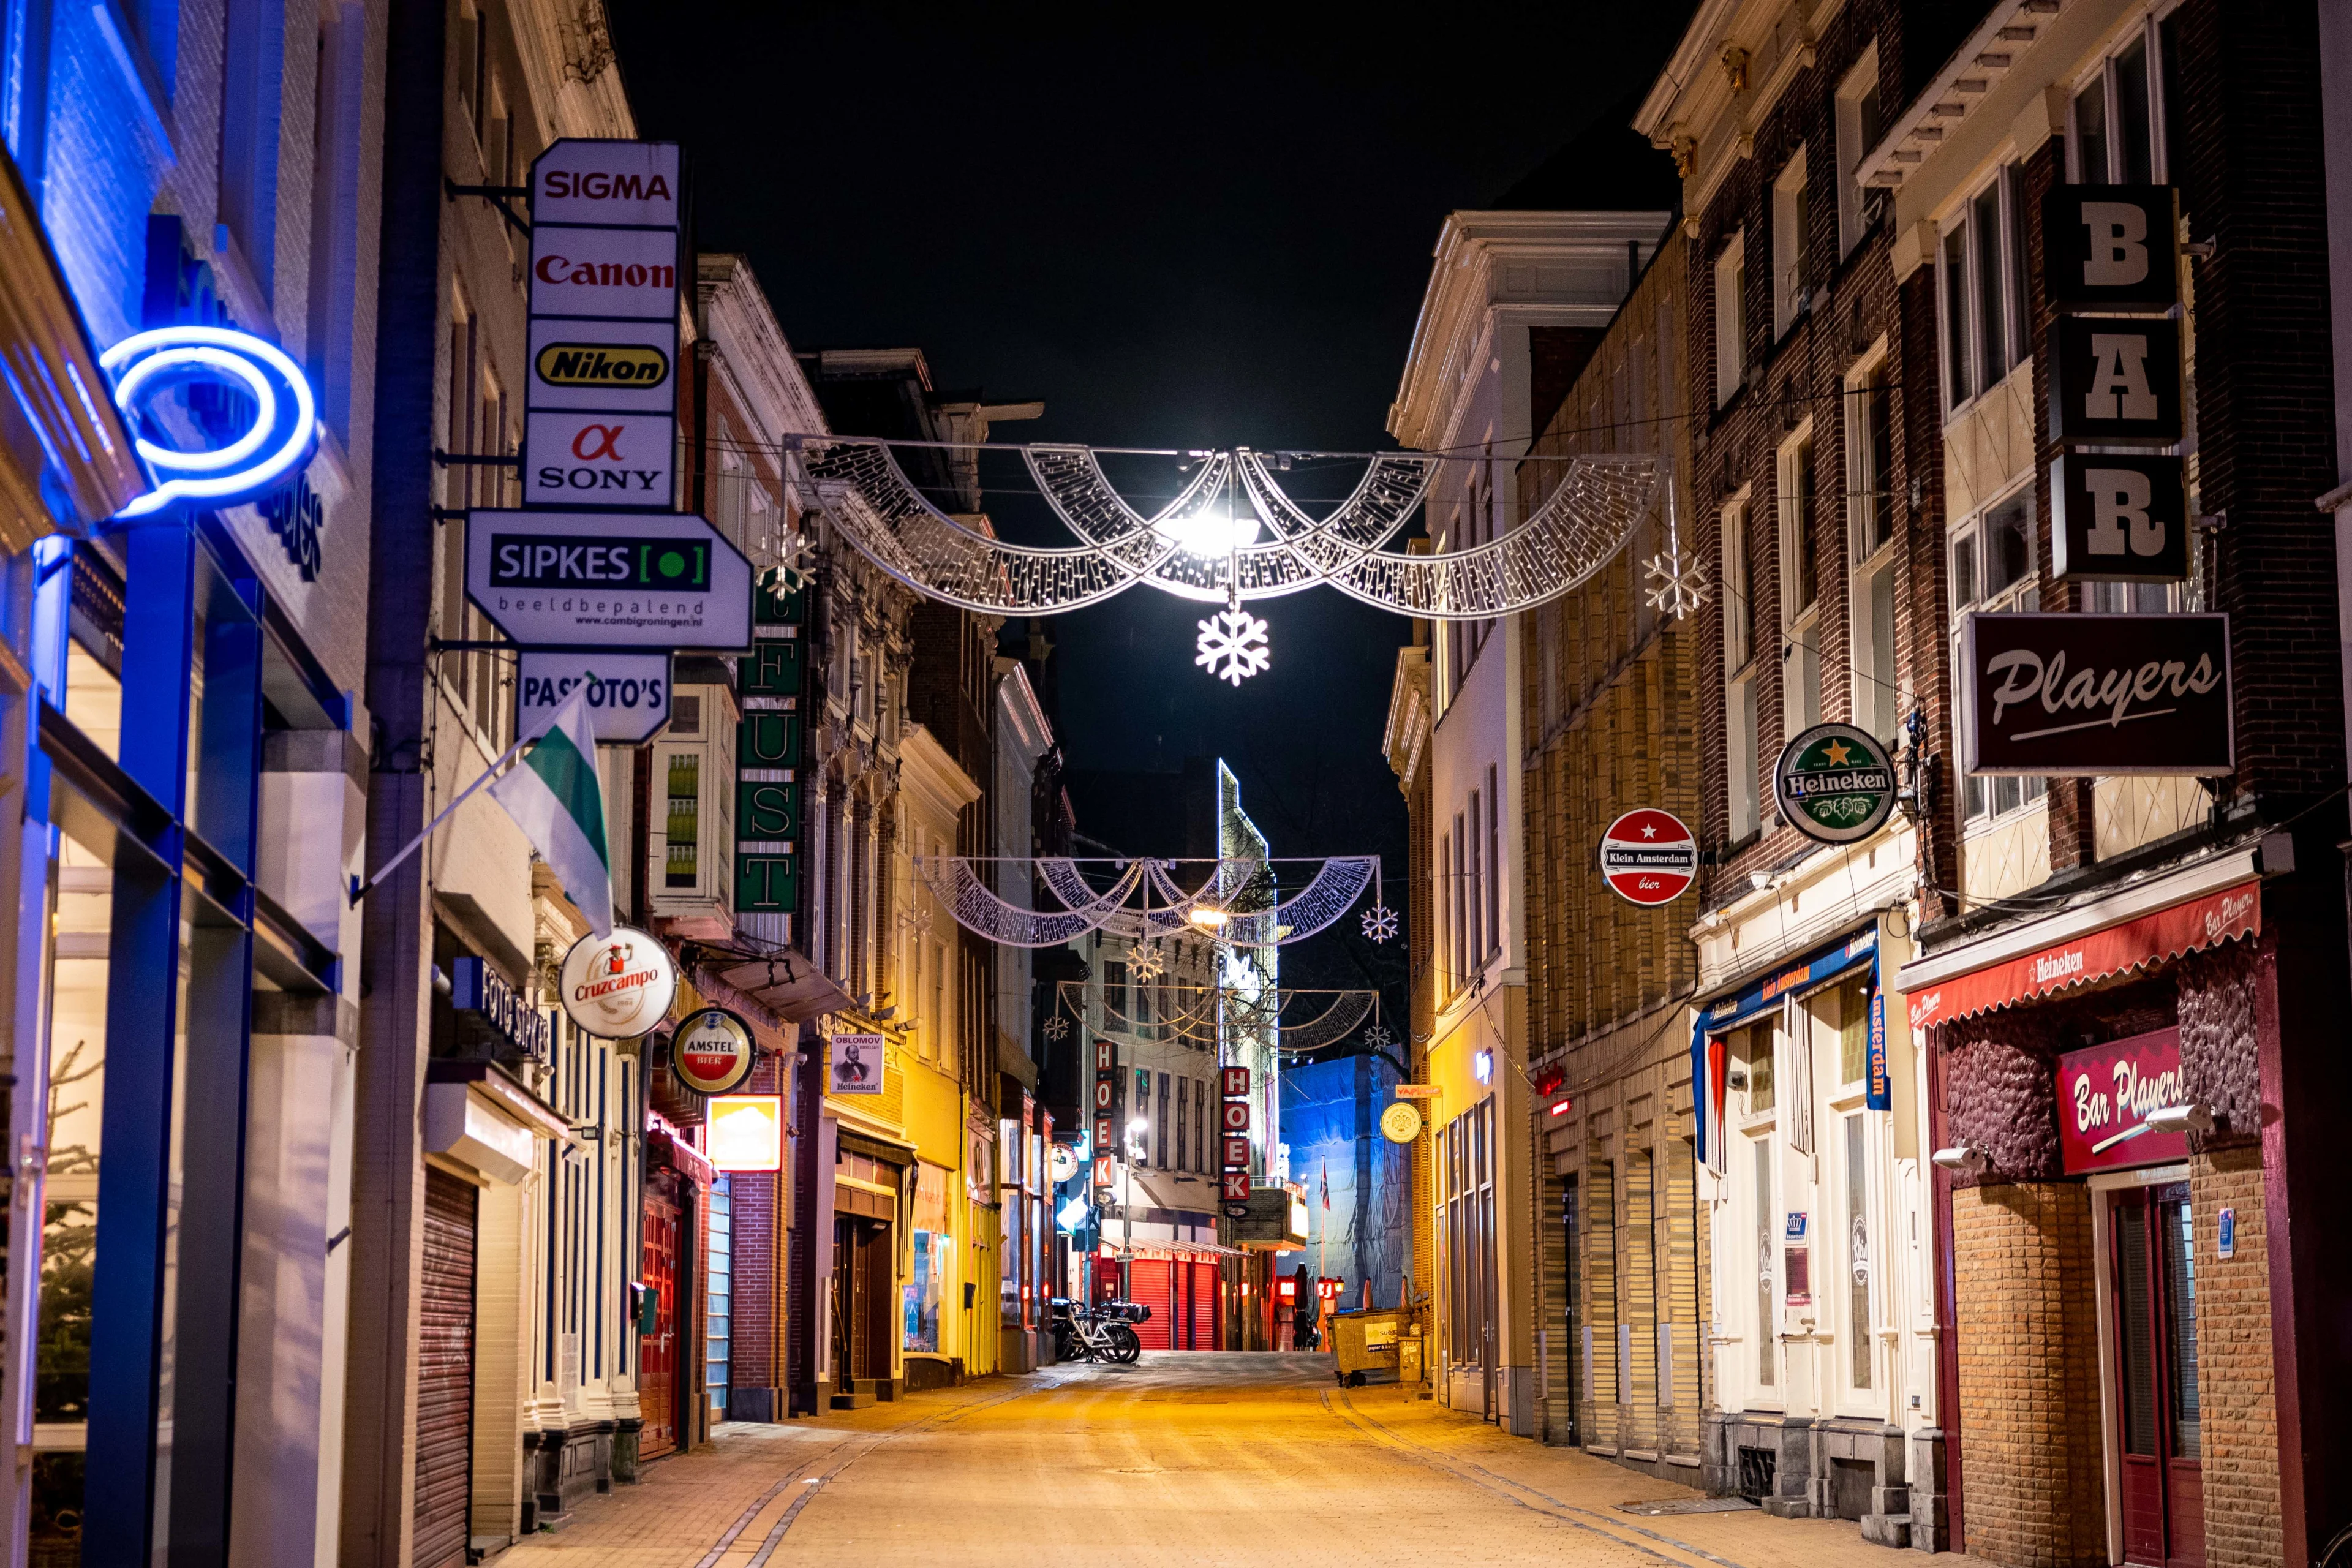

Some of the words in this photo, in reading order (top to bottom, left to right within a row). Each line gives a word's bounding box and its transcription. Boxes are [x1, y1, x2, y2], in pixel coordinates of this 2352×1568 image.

[544, 170, 672, 201] SIGMA
[535, 254, 674, 288] Canon
[550, 350, 662, 381] Nikon
[2081, 201, 2166, 557] BAR
[538, 467, 663, 490] SONY
[497, 544, 631, 581] SIPKES
[499, 596, 704, 616] beeldbepalend
[575, 615, 703, 628] www.combigroningen.nl
[1986, 649, 2222, 728] Players
[1788, 771, 1887, 796] Heineken
[1610, 853, 1634, 863] Klein
[1636, 853, 1689, 864] Amsterdam
[1638, 876, 1660, 889] bier
[2205, 911, 2221, 936] Bar
[2222, 892, 2254, 924] Players
[1762, 978, 1777, 1002] Klein
[1776, 963, 1811, 994] Amsterdam
[2036, 950, 2083, 984] Heineken
[575, 968, 658, 1002] Cruzcampo
[1713, 998, 1738, 1021] Heineken
[1910, 1004, 1921, 1025] Bar
[688, 1041, 734, 1052] AMSTEL
[1872, 985, 1885, 1096] Amsterdam
[696, 1057, 722, 1065] BIER
[837, 1082, 876, 1091] Heineken
[2074, 1073, 2111, 1133] Bar
[2113, 1060, 2184, 1124] Players
[1098, 1045, 1110, 1183] HOEK
[1227, 1071, 1247, 1197] HOEK
